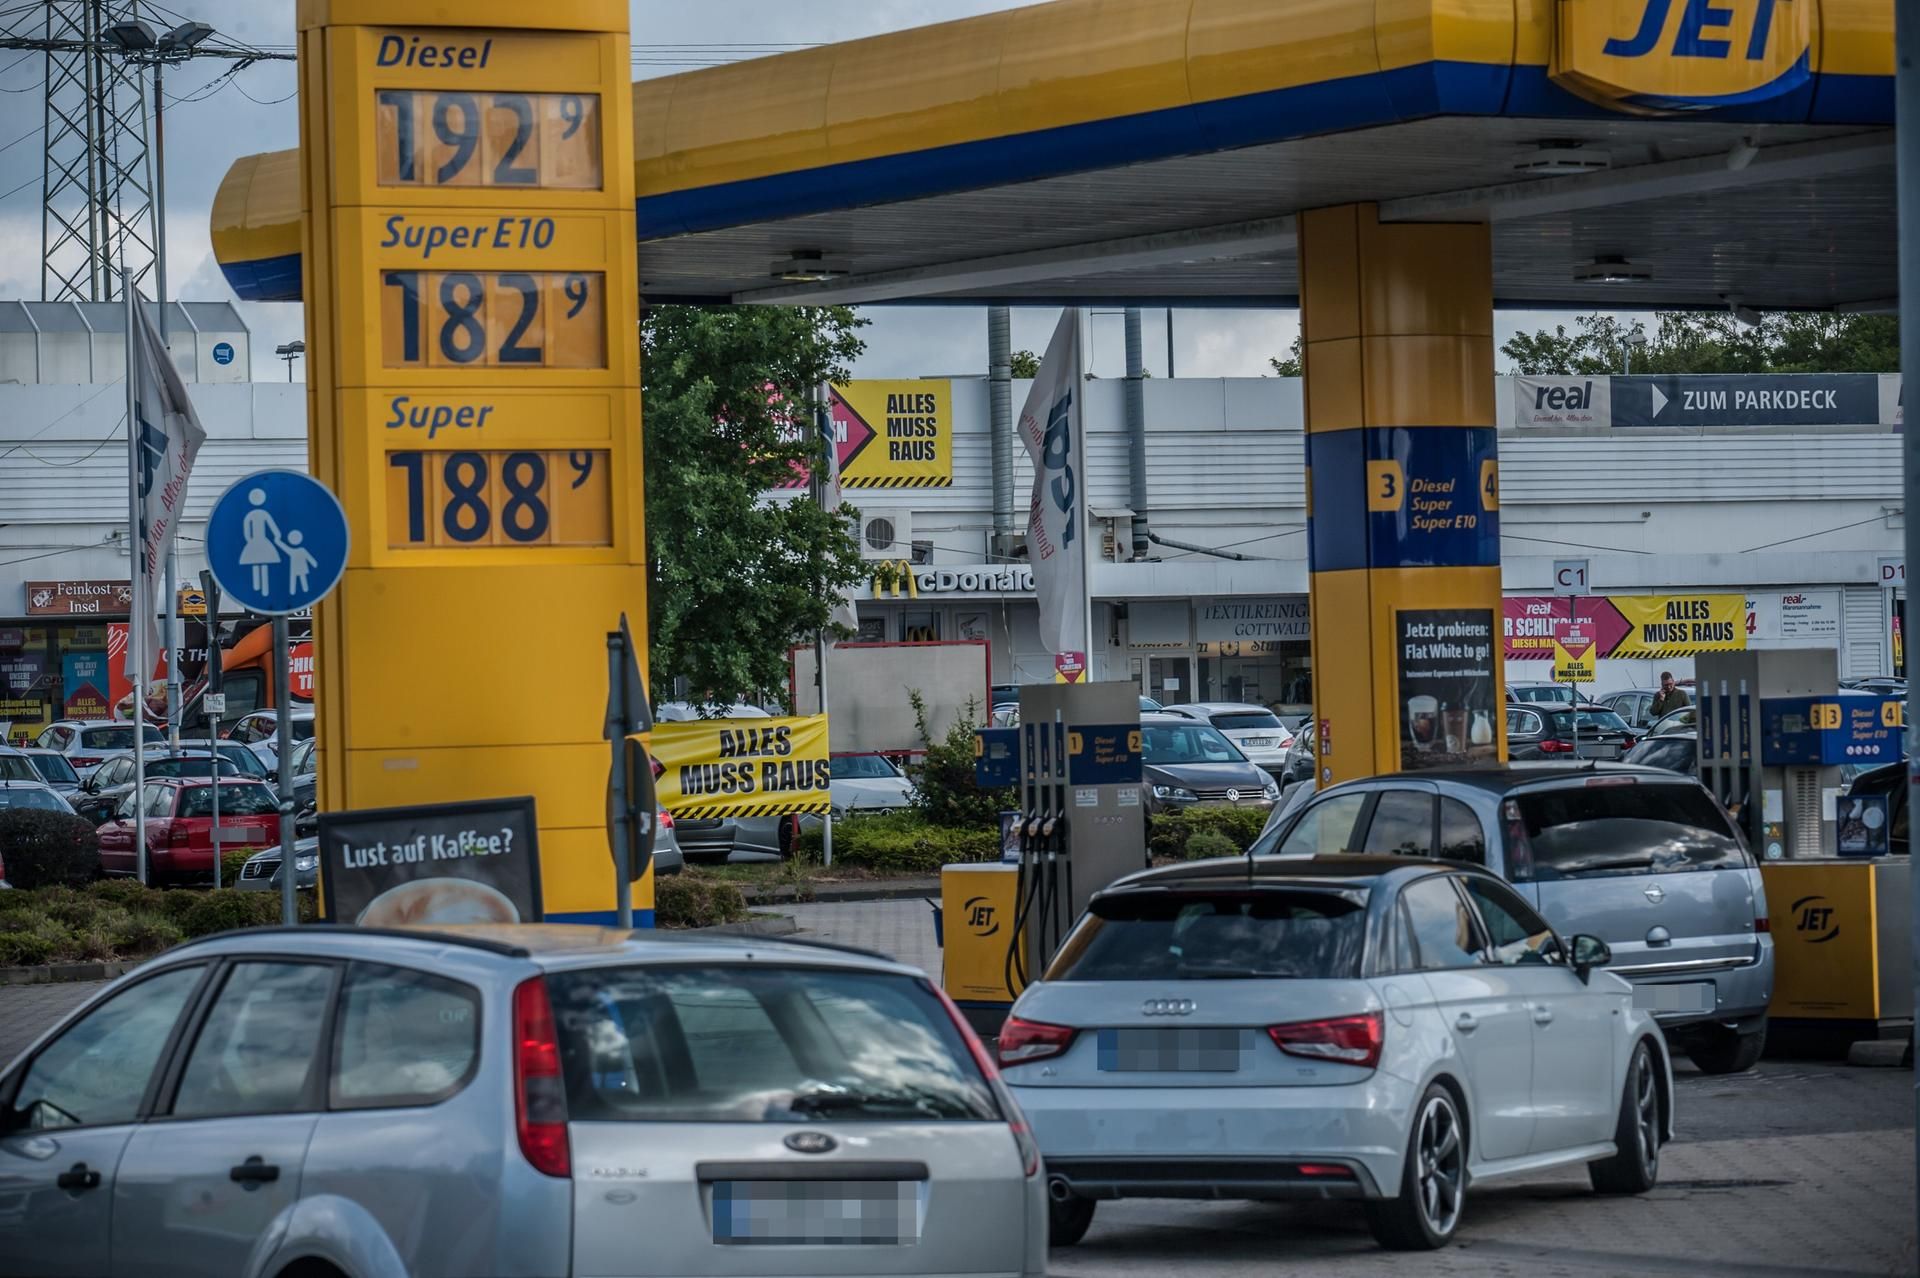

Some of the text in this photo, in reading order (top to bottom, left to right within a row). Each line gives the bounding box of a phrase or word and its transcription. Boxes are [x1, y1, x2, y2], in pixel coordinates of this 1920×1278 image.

[376, 35, 493, 68] Diesel
[381, 215, 556, 259] Super E10
[886, 393, 936, 414] ALLES
[1534, 381, 1593, 410] real
[1683, 389, 1837, 411] ZUM PARKDECK
[386, 396, 495, 440] Super
[886, 417, 937, 438] MUSS
[889, 440, 936, 461] RAUS
[1380, 473, 1396, 499] 3
[1411, 478, 1456, 493] Diesel
[1484, 473, 1496, 497] 4
[1411, 497, 1453, 515] Super
[1411, 515, 1477, 533] Super E10
[57, 582, 112, 596] Feinkost
[69, 600, 100, 613] Insel
[1526, 601, 1552, 615] real
[1665, 600, 1710, 621] ALLES
[1745, 600, 1756, 609] or
[1405, 621, 1489, 640] Jetzt probieren:
[1643, 622, 1734, 643] MUSS RAUS
[1405, 643, 1490, 661] Flat White to go!
[1512, 638, 1538, 649] DIESEN
[67, 706, 87, 714] MUSS
[77, 698, 96, 706] ALLES
[1813, 708, 1820, 724] 3
[1829, 709, 1838, 724] 3
[1885, 707, 1895, 722] 4
[719, 725, 792, 758] ALLES
[1071, 736, 1077, 750] 1
[1132, 736, 1140, 749] 2
[680, 758, 830, 796] MUSS RAUS
[343, 828, 514, 869] Lust auf Kaffee?
[968, 907, 995, 927] JET
[1797, 907, 1834, 931] JET
